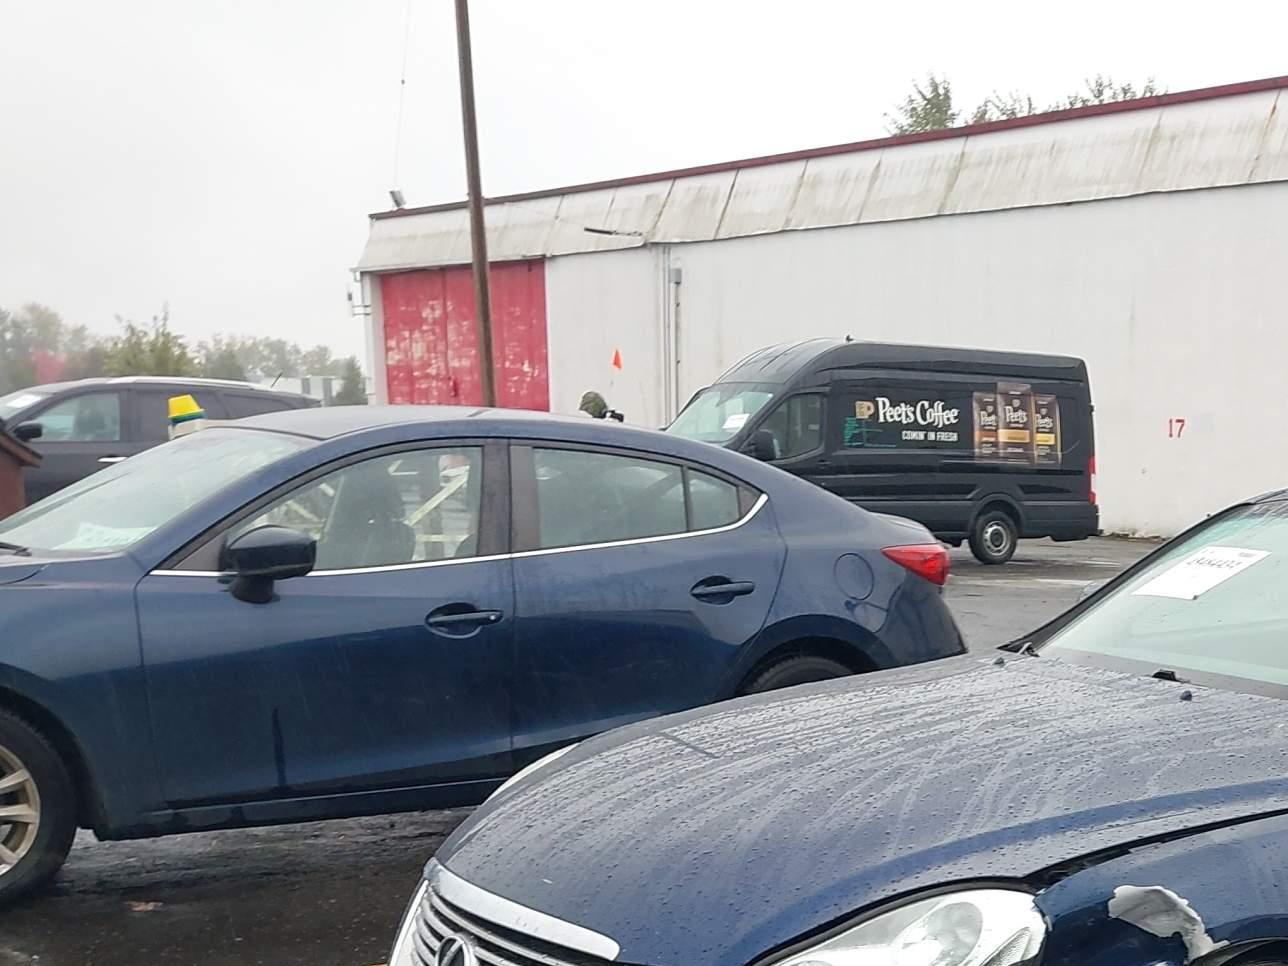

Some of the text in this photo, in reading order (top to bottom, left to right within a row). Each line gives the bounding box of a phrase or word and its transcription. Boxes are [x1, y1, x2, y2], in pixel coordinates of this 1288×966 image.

[875, 397, 960, 428] Peet's Coffee
[927, 431, 935, 441] IN
[936, 432, 958, 441] FRESH
[1168, 419, 1185, 438] 17
